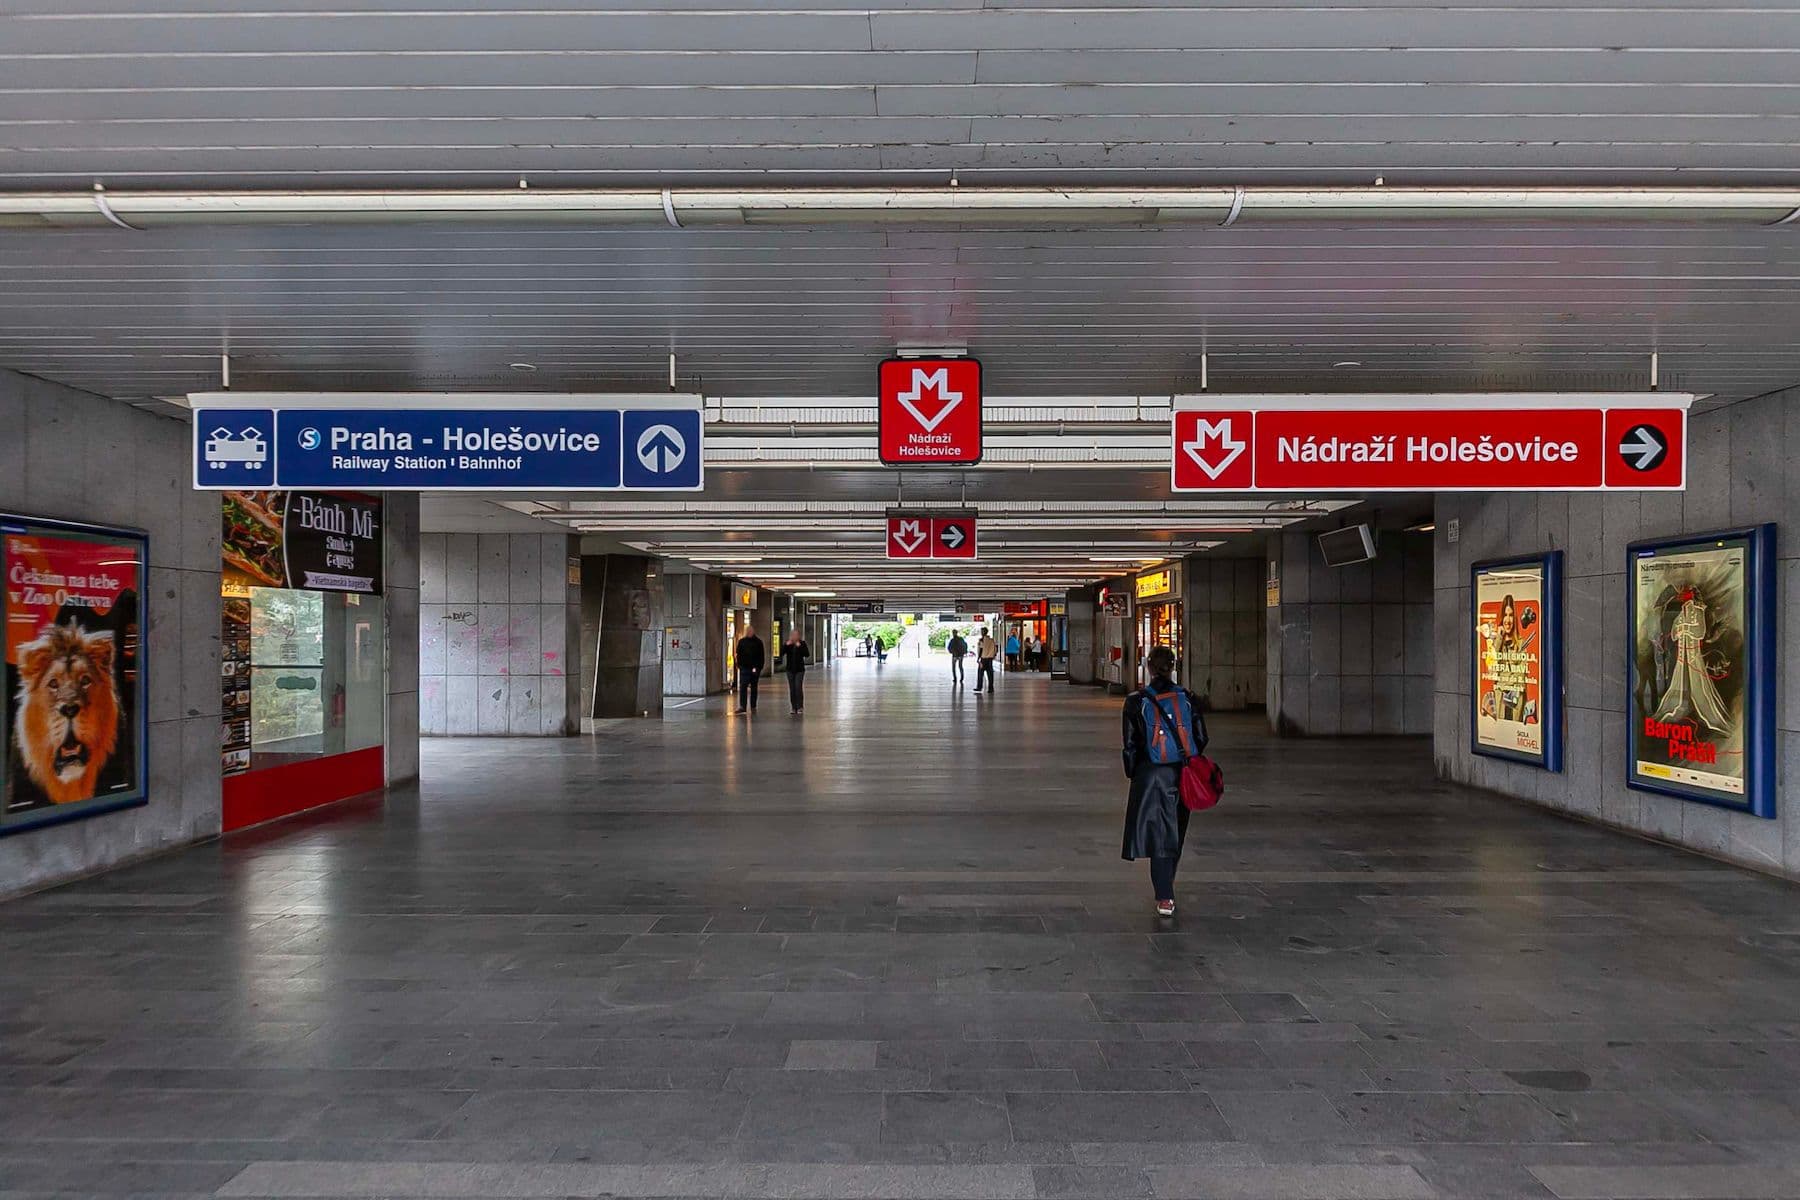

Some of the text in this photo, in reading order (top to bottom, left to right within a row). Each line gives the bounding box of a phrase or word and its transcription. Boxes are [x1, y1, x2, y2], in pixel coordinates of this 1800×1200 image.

[331, 427, 413, 450] Praha
[443, 426, 600, 451] Holešovice
[909, 432, 952, 443] Nádraží
[899, 445, 961, 456] Holešovice
[1277, 435, 1579, 462] Nádraží Holešovice
[332, 455, 522, 472] Railway Station Bahnhof
[68, 575, 86, 588] na
[89, 573, 119, 590] tebe
[23, 587, 52, 605] Zoo
[55, 588, 112, 608] Ostrava
[1645, 717, 1693, 741] Baron
[1668, 740, 1716, 765] Prášil
